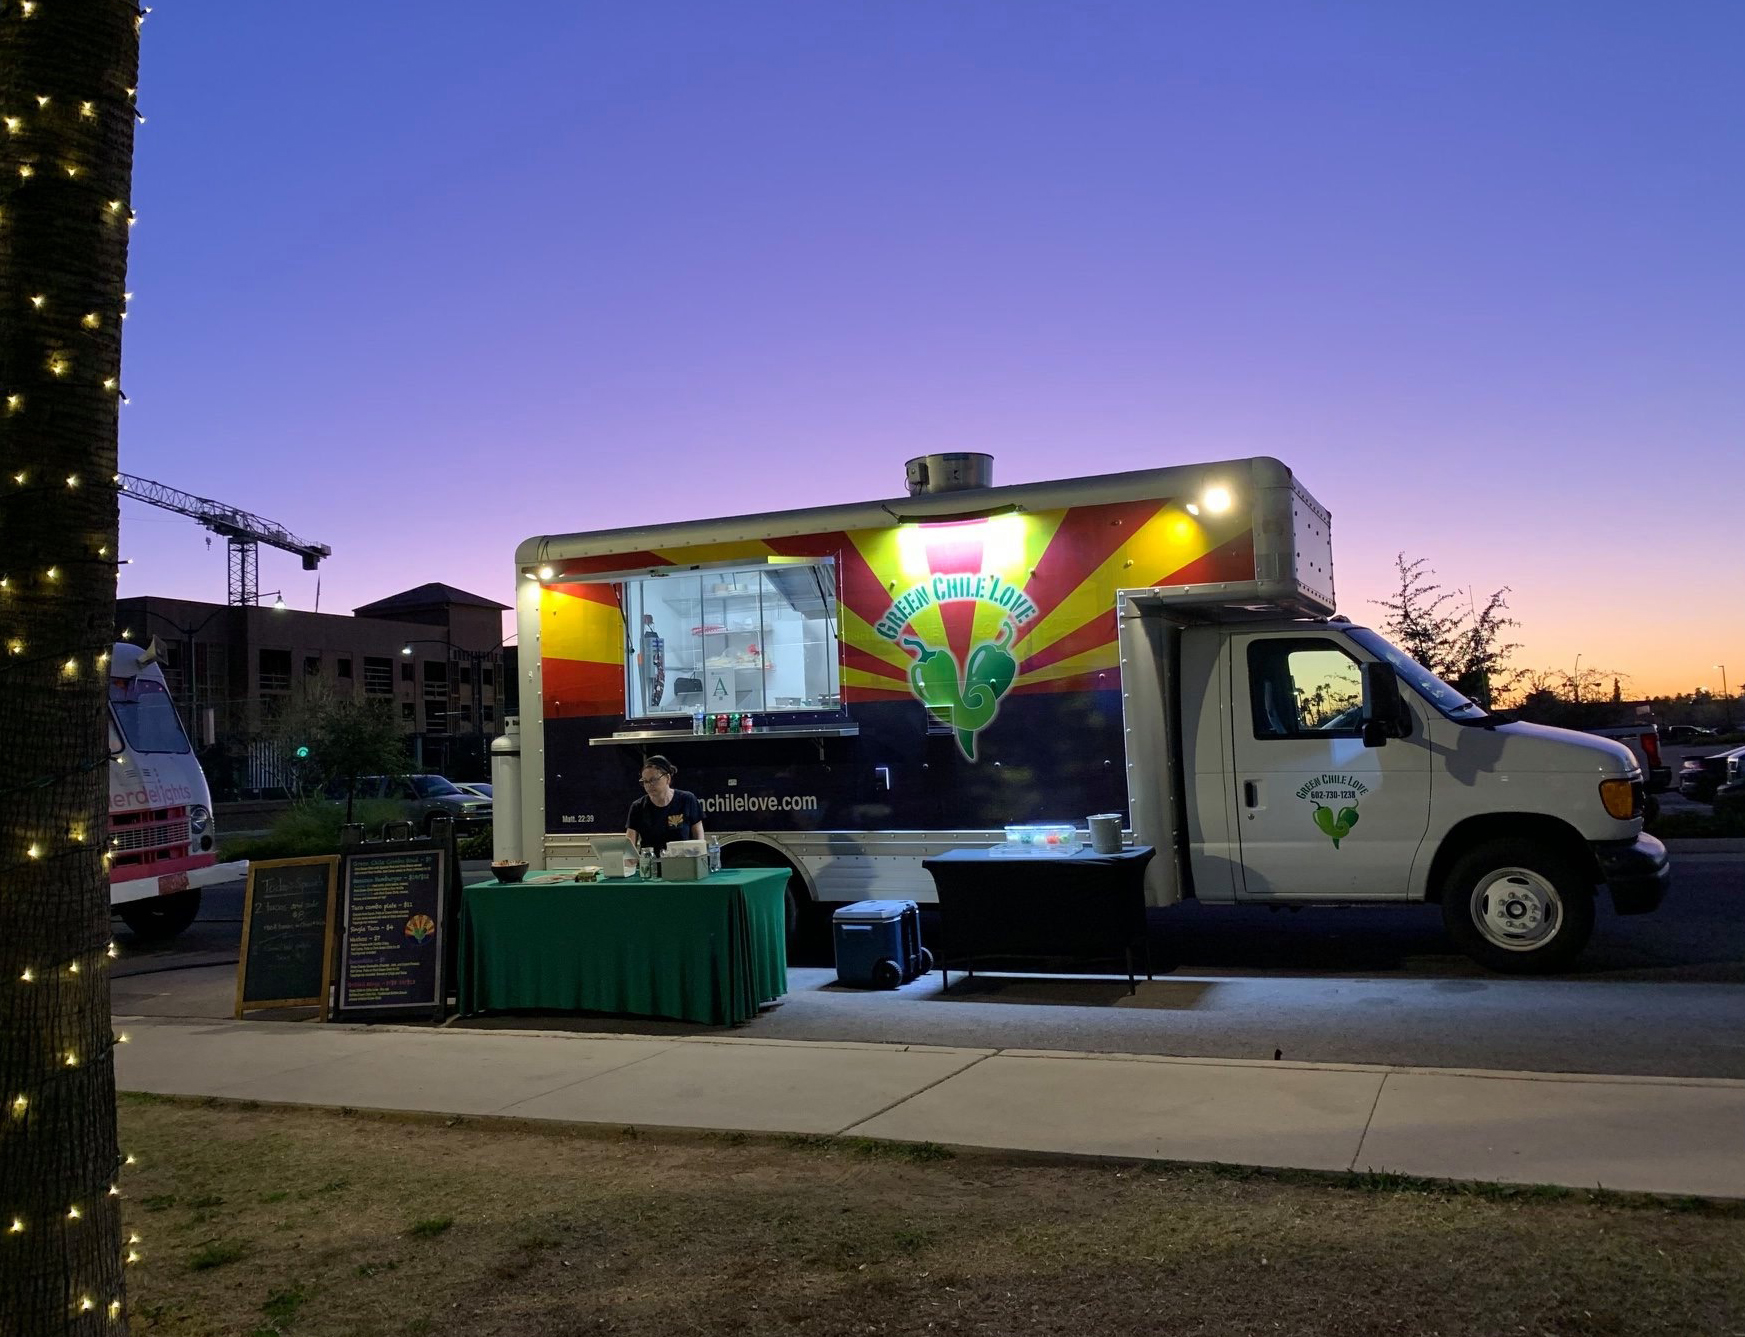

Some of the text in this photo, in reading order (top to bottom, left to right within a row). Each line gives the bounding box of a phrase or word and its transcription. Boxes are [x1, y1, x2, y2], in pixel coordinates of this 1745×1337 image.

[875, 575, 1037, 640] GREEN CHILE LOVE
[713, 677, 729, 697] A
[1296, 774, 1369, 800] GREEN CHILE LOVE
[1311, 791, 1356, 799] 602-730-1238
